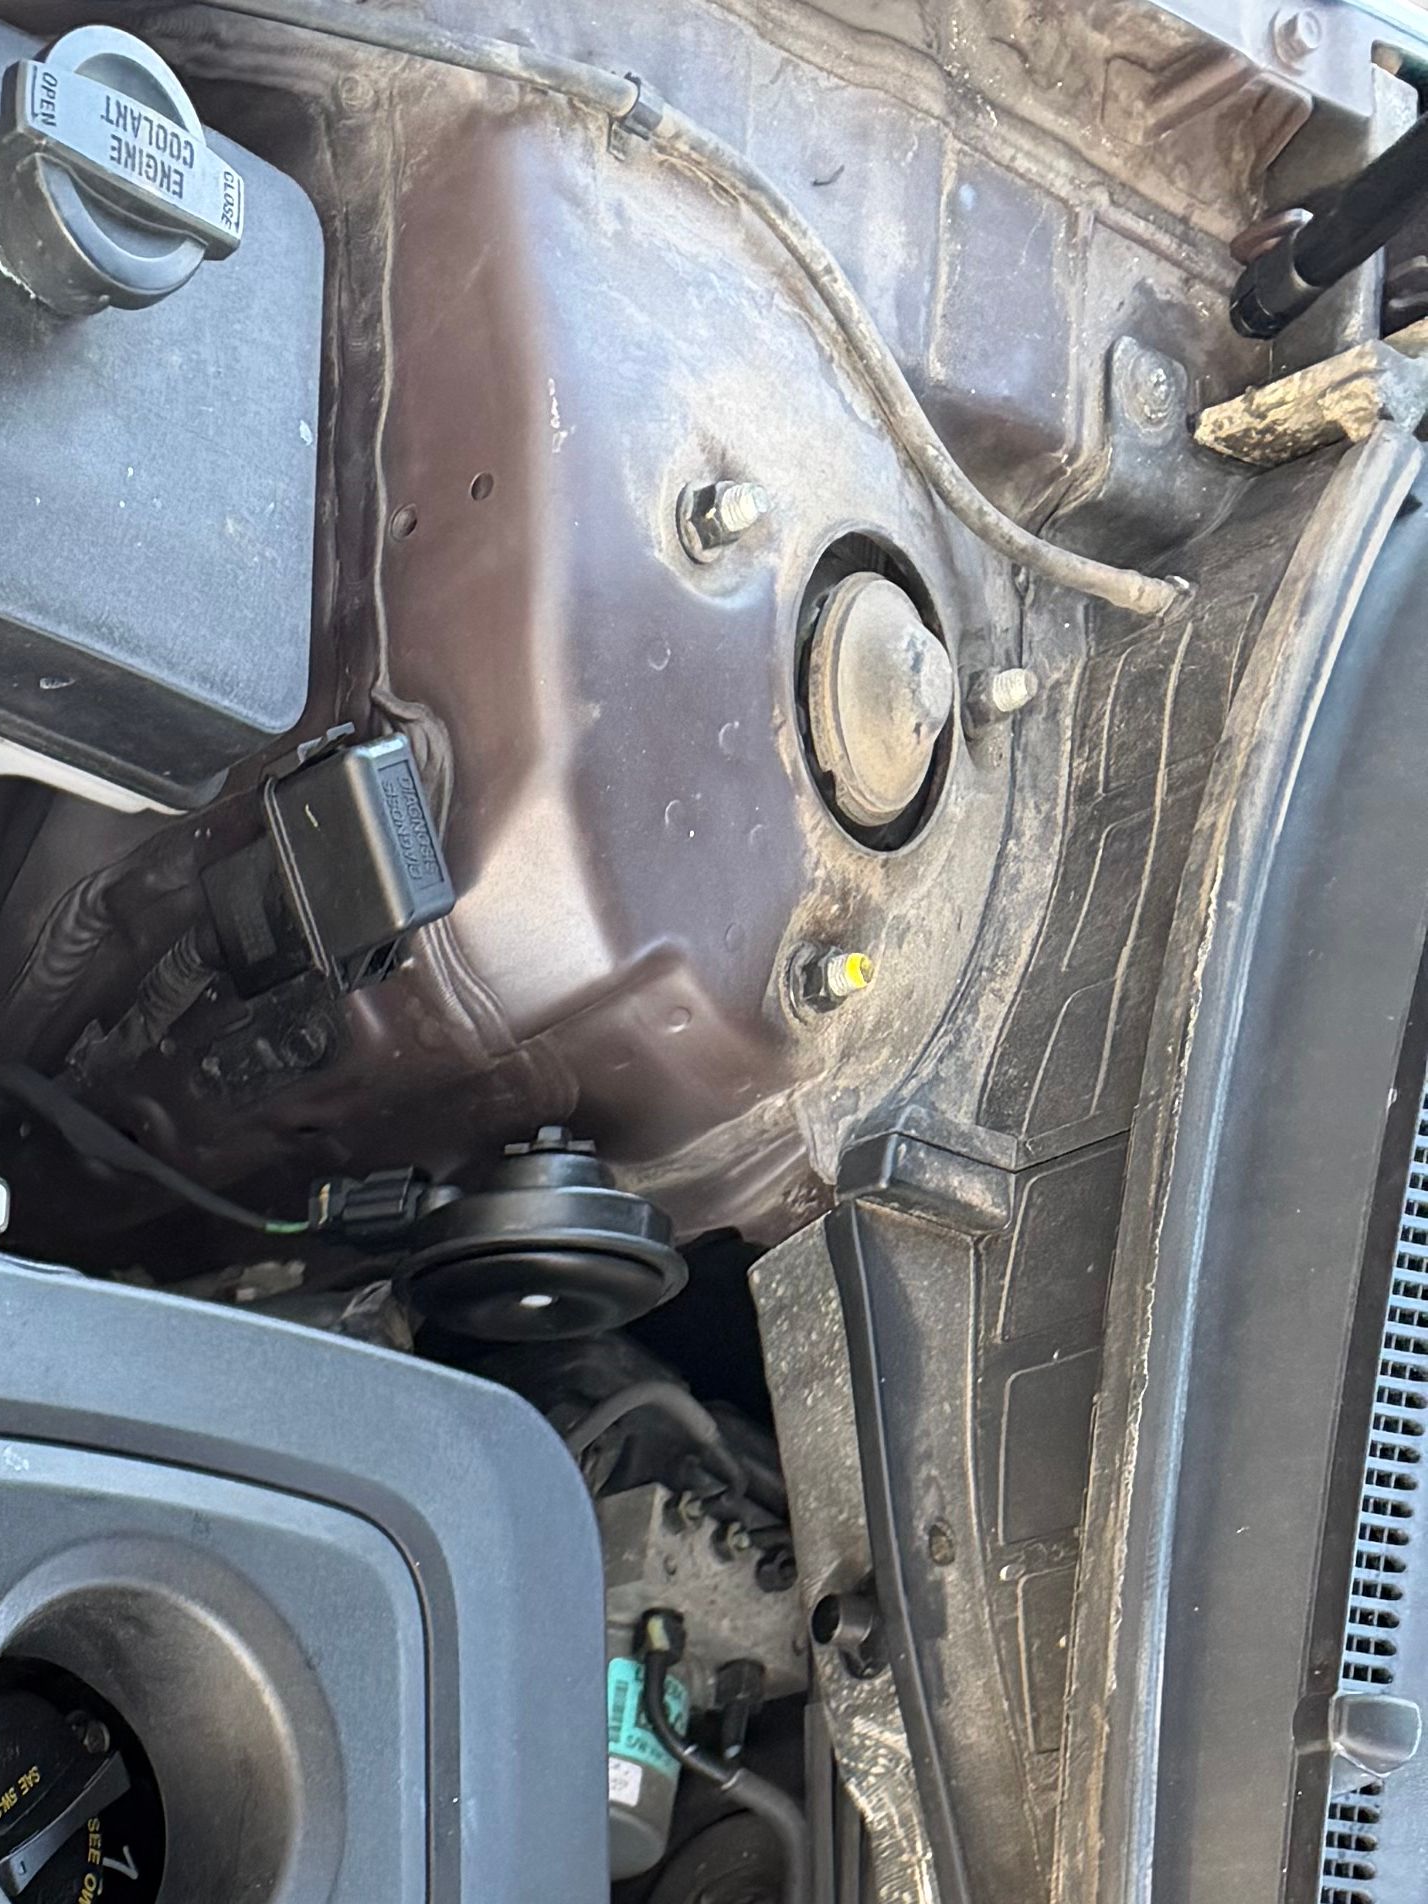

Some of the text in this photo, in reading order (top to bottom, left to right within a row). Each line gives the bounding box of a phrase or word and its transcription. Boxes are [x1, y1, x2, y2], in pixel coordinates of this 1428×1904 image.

[40, 71, 58, 127] OPEN
[101, 95, 195, 169] COOLANT
[110, 134, 185, 199] ENGINE
[221, 171, 235, 228] CLOSE
[18, 1766, 41, 1796] SAE
[87, 1817, 102, 1865] SEE
